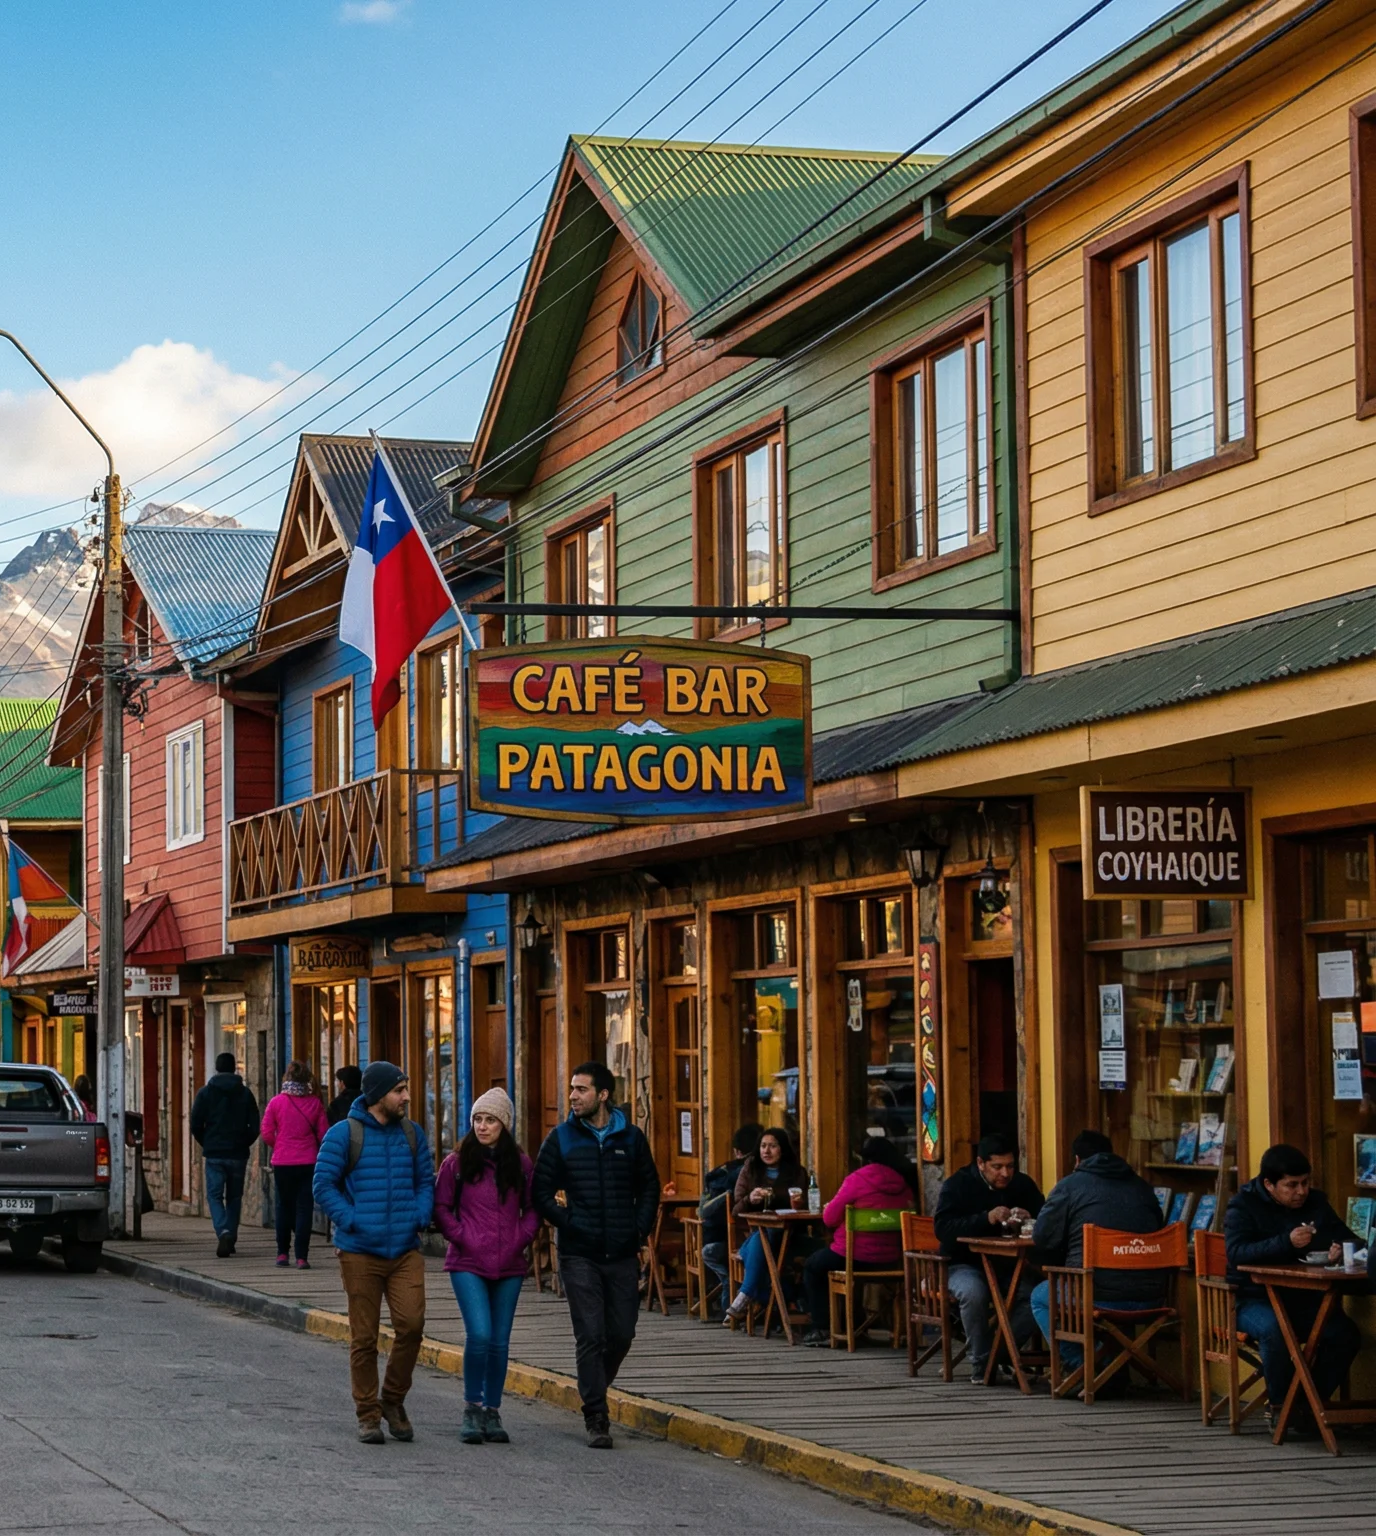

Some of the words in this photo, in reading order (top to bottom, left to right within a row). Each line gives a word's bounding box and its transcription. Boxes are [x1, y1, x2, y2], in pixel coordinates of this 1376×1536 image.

[512, 651, 644, 713] CAFÉ
[666, 666, 770, 714] BAR
[497, 743, 787, 793] PATAGONIA
[1098, 797, 1238, 842] LIBRERÍA
[1097, 851, 1241, 887] COYHAIQUE
